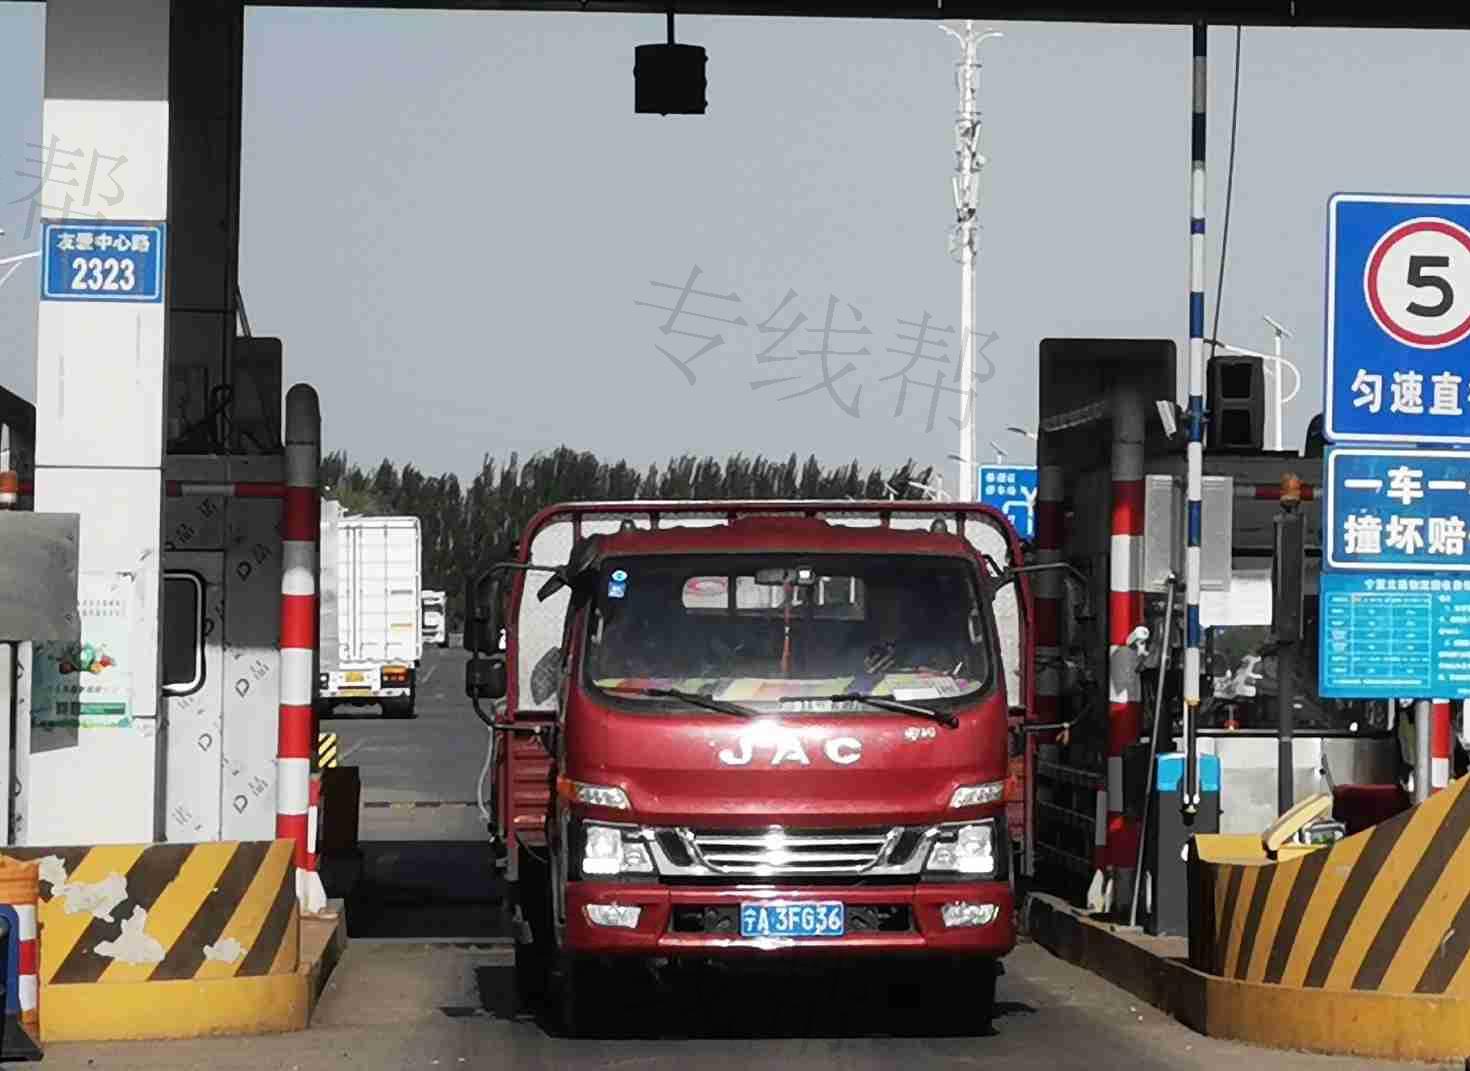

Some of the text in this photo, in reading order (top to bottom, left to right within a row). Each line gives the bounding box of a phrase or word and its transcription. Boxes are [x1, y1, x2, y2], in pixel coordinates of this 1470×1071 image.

[71, 256, 136, 291] 2323
[1406, 255, 1455, 318] 5
[719, 734, 863, 766] JAC
